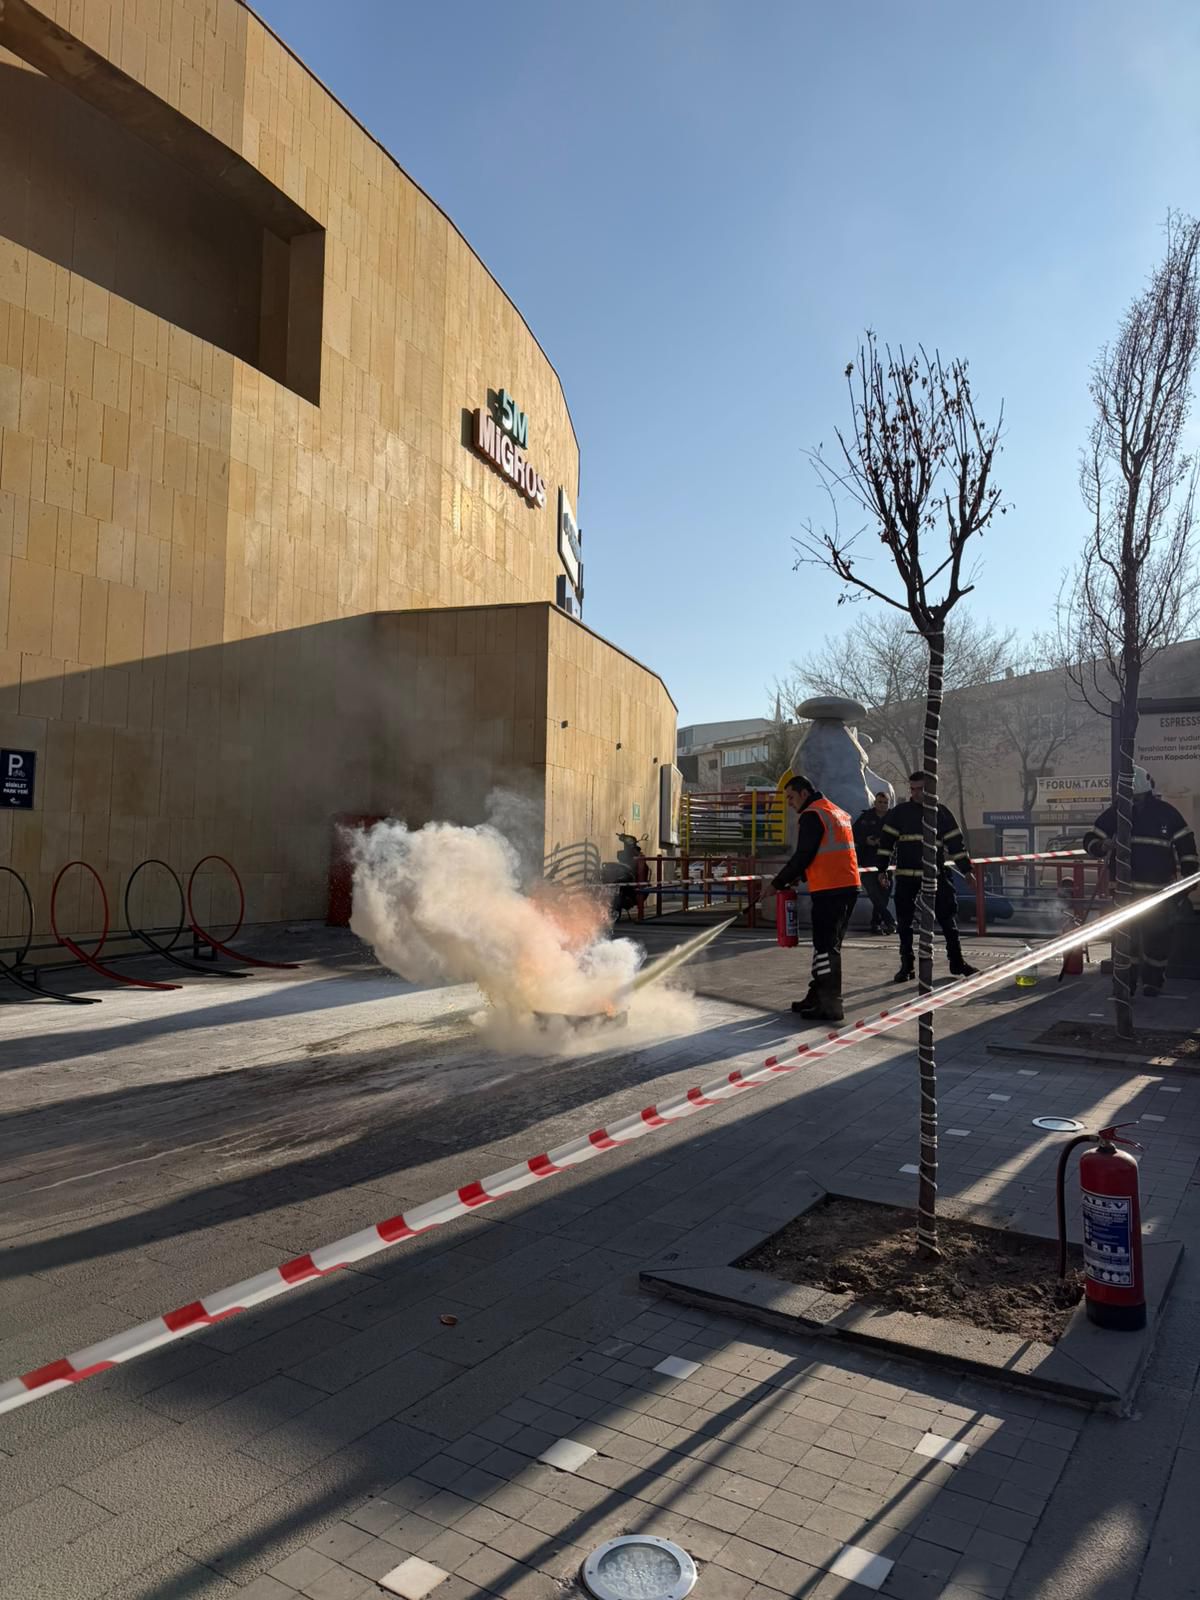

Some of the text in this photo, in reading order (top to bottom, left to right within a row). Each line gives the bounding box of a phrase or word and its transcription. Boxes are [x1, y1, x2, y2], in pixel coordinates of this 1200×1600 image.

[501, 388, 528, 449] 5M
[8, 754, 24, 776] P
[1046, 778, 1110, 790] FORUM TAKS
